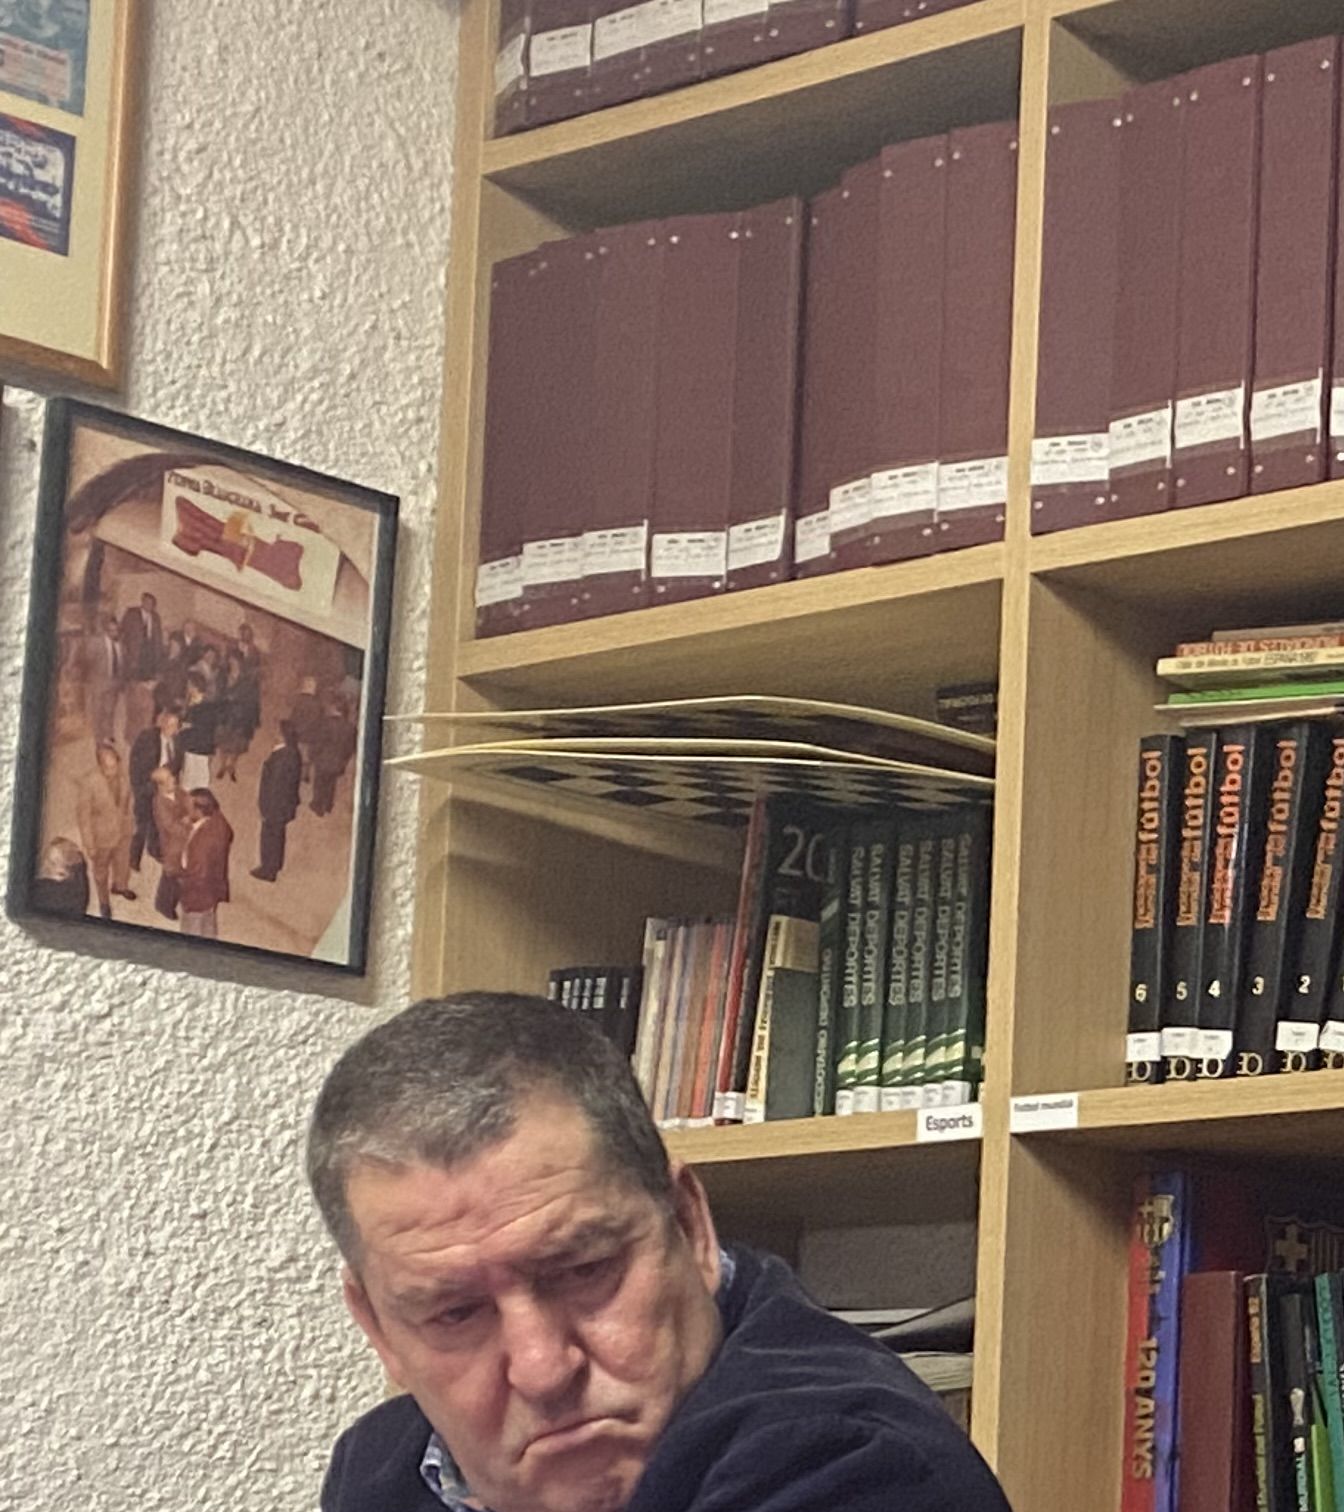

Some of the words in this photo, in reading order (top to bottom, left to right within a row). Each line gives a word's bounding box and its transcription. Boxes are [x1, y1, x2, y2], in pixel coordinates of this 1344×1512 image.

[1135, 983, 1148, 1001] 6
[1175, 980, 1188, 1000] 5
[1207, 978, 1221, 998] 4
[1251, 976, 1264, 995] 3
[1298, 974, 1311, 994] 2
[925, 1114, 974, 1133] Esports
[1132, 1400, 1156, 1480] ANYS
